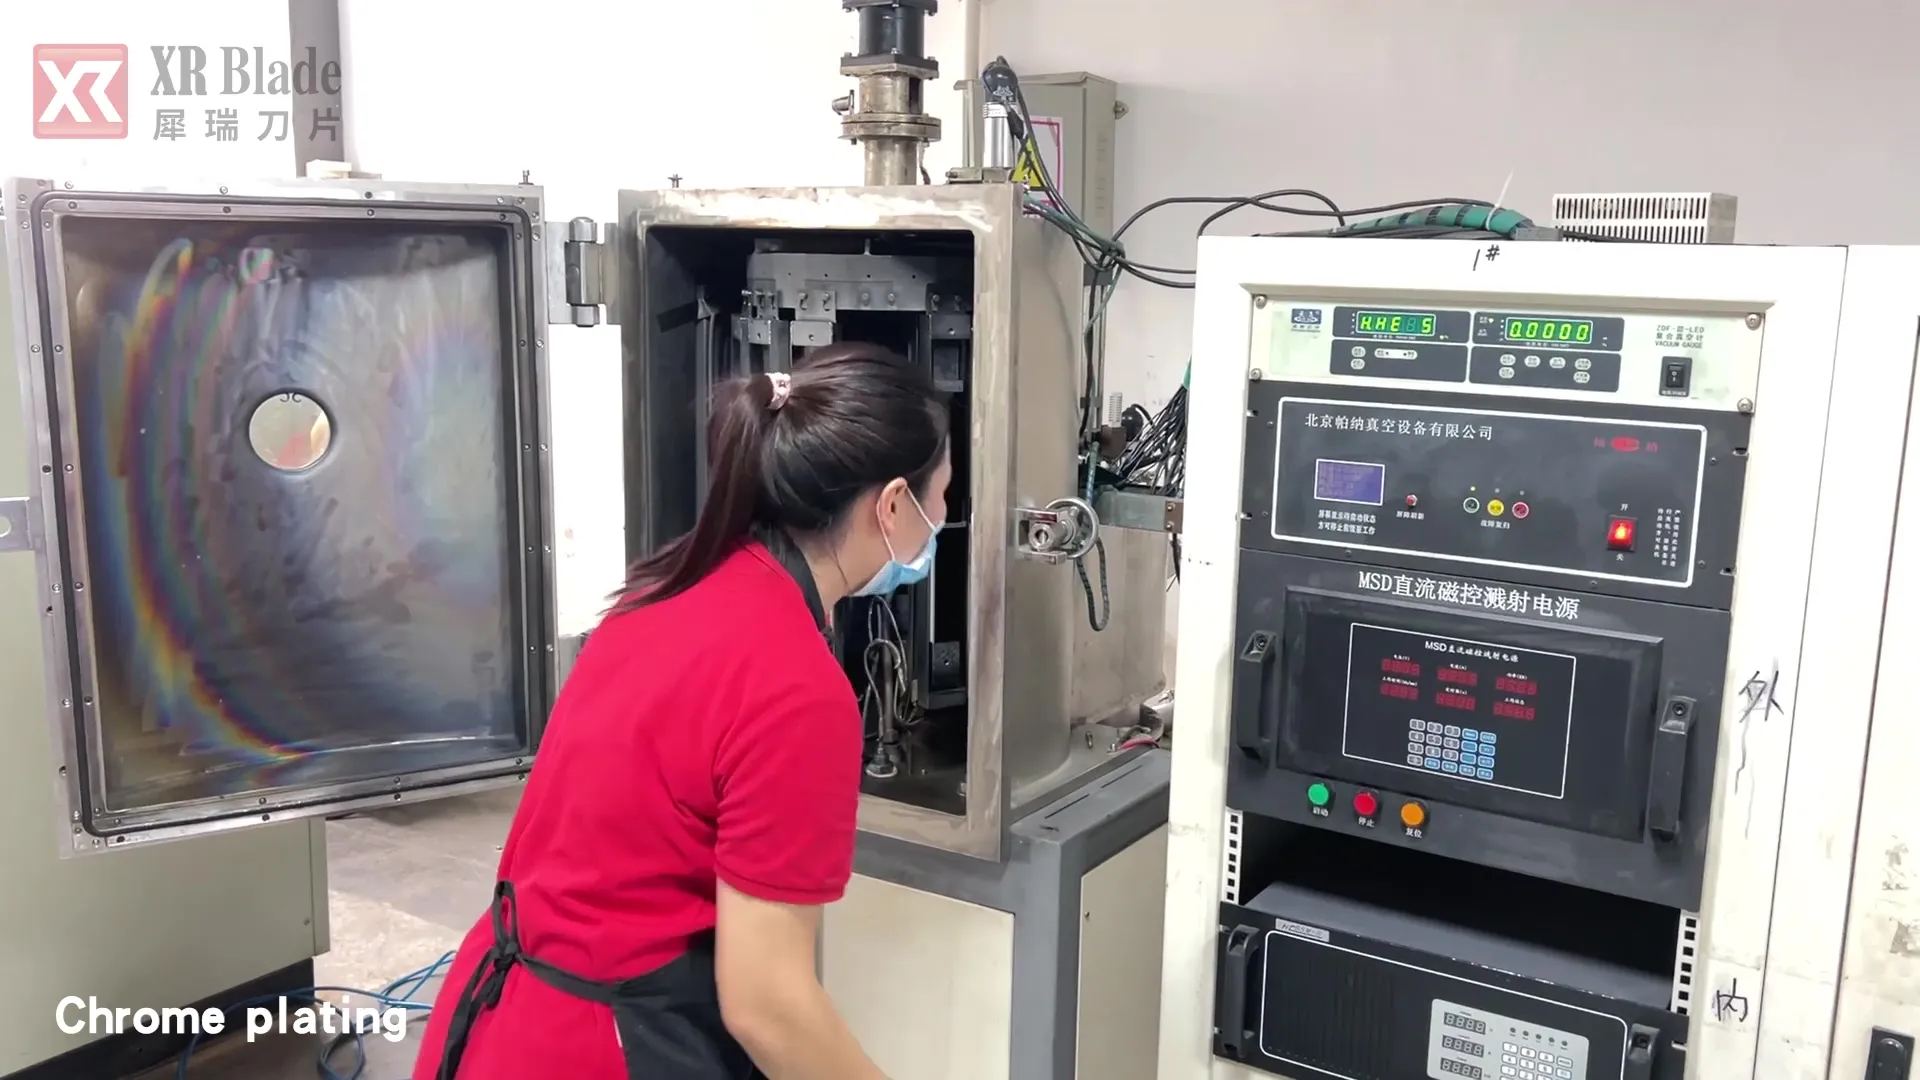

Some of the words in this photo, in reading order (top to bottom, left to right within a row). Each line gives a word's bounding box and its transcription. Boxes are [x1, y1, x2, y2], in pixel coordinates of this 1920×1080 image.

[1681, 341, 1703, 349] GAUGE
[1304, 412, 1493, 441] 北京帕纳真空设备有限公司
[1358, 571, 1581, 620] MSD直流磁控溅射电源
[1312, 806, 1329, 817] 启动
[1358, 816, 1375, 828] 停止
[1405, 827, 1422, 838] 复位
